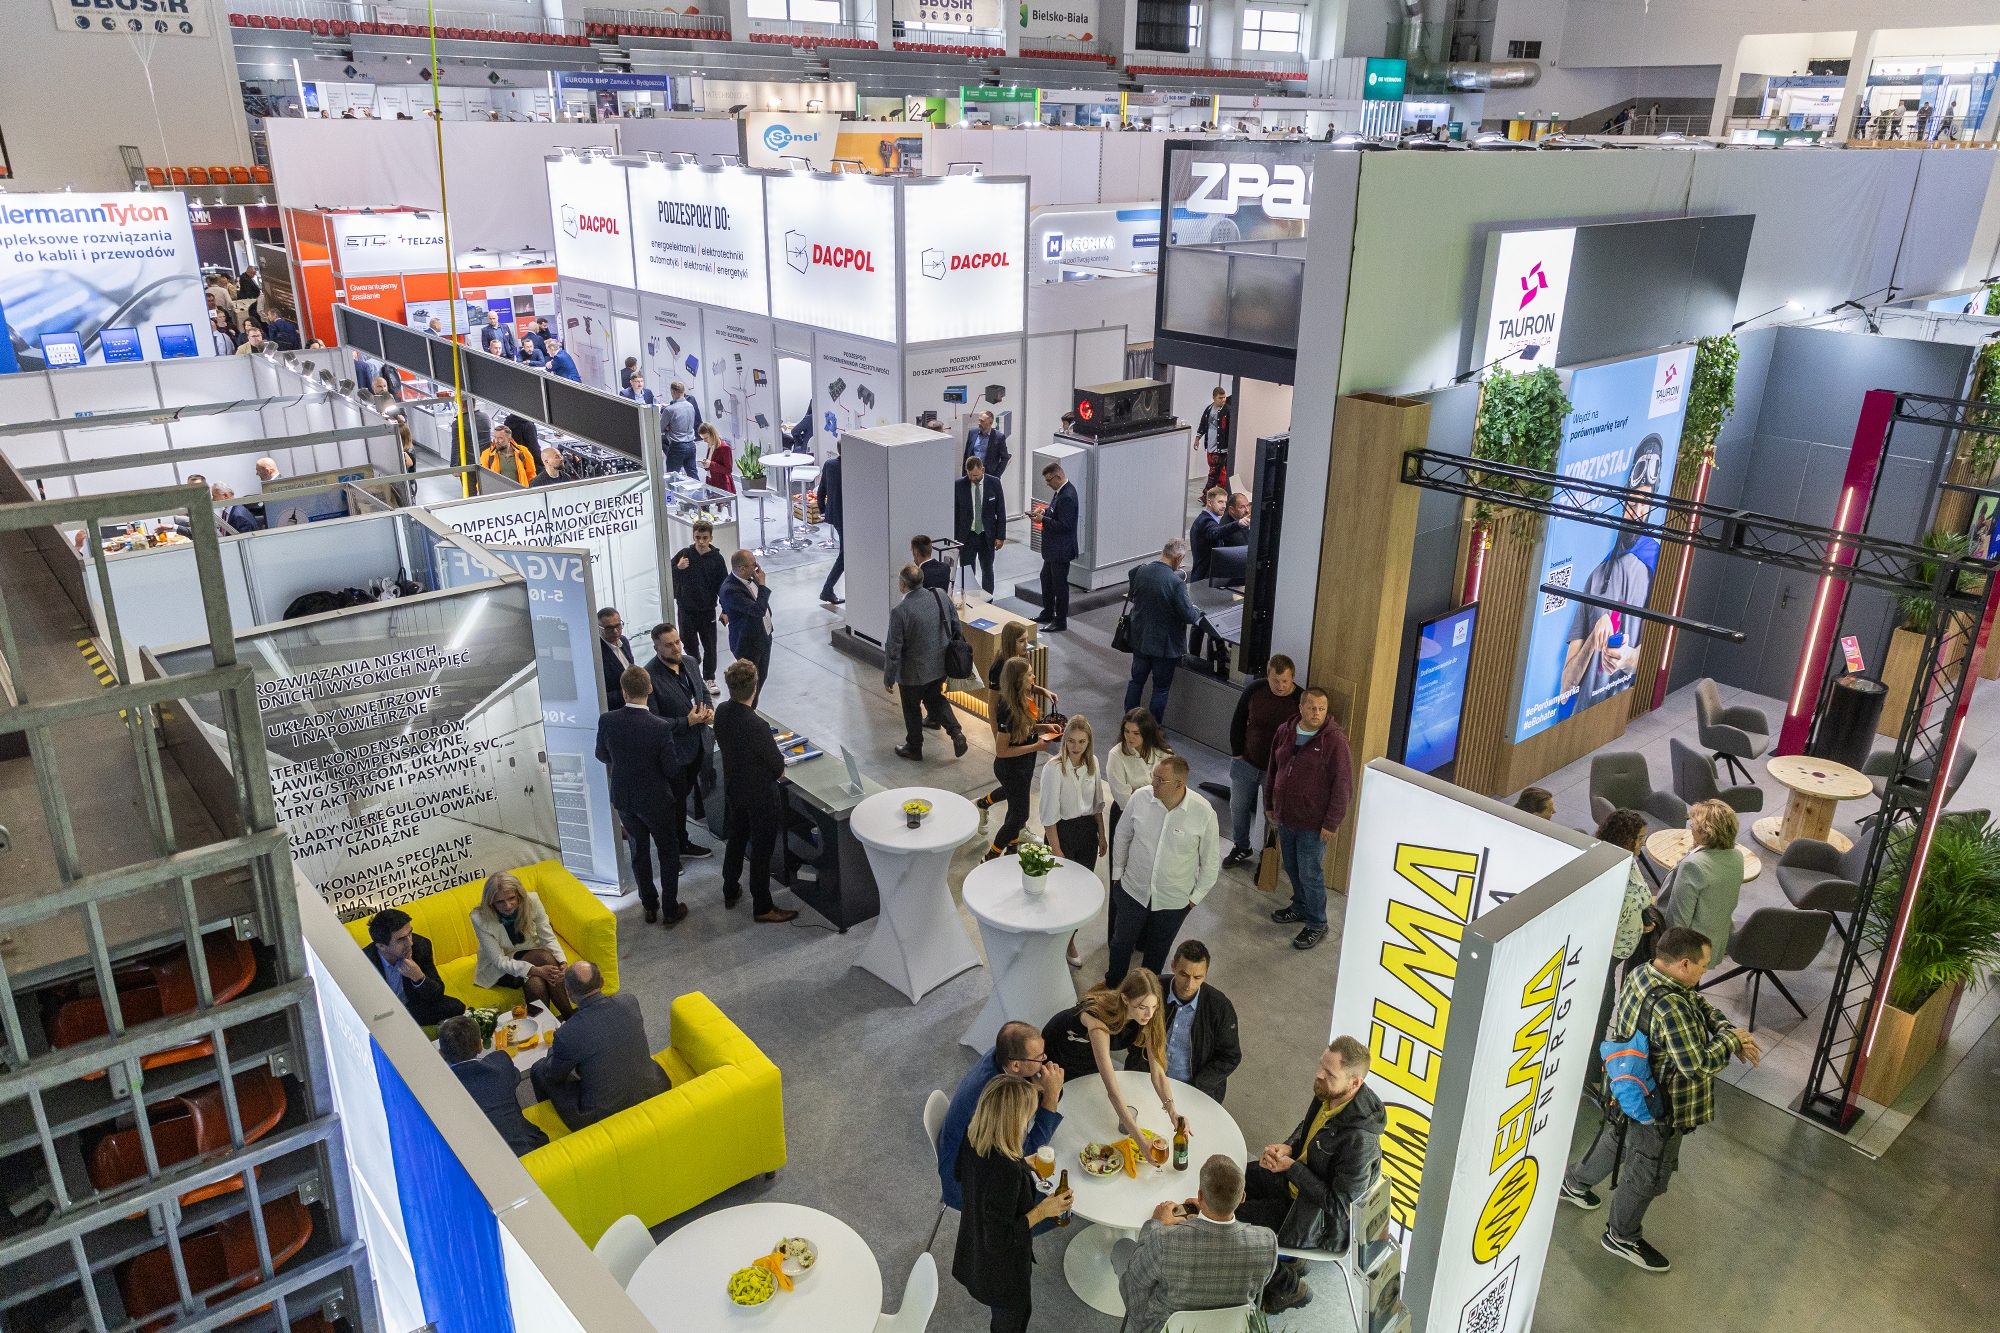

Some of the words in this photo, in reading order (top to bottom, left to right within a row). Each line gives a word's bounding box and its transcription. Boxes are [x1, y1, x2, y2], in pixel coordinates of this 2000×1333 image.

[1032, 10, 1089, 24] Bielsko-Biała
[565, 76, 594, 84] EURODIS
[773, 131, 818, 142] Sonel
[0, 204, 168, 226] lermannTyton
[579, 214, 619, 235] DACPOL
[658, 200, 712, 228] PODZESPOŁY
[714, 206, 731, 230] DO:
[84, 230, 172, 245] rozwiązania
[408, 236, 444, 246] TELZAS
[652, 240, 696, 254] energoelektroniki
[702, 246, 744, 261] elektrotechniki
[14, 250, 34, 262] do
[38, 248, 78, 262] kabli
[82, 248, 87, 260] i
[91, 246, 175, 263] przewodów
[650, 255, 680, 268] automatyki
[684, 260, 712, 273] elektroniki
[717, 266, 748, 280] energetyki
[812, 244, 874, 272] DACPOL
[950, 252, 1009, 270] DACPOL
[350, 282, 398, 292] Gwarantujemy
[1499, 312, 1556, 340] TAURON
[950, 354, 981, 364] PODZESPOŁY
[1570, 422, 1614, 442] porównywarkę
[1614, 416, 1629, 430] taryf
[1573, 410, 1591, 424] Wejdź
[1591, 410, 1598, 419] na
[1564, 446, 1634, 482] KORZYSTAJ
[270, 483, 304, 493] ELECTRICAL
[306, 479, 327, 488] SAFETY
[449, 510, 546, 534] OMPENSACJA
[552, 501, 591, 518] MOCY
[594, 492, 644, 511] BIERNEJ
[469, 528, 518, 544] RACJA
[524, 506, 644, 537] HARMONICZNYCH
[507, 531, 585, 547] OWANIE
[588, 520, 638, 539] ENERGII
[374, 644, 442, 670] NISKICH,
[258, 686, 314, 712] DNICH
[327, 665, 412, 695] WYSOKICH
[415, 648, 470, 674] NAPIĘĆ
[268, 710, 336, 738] UKŁADY
[339, 685, 442, 720] WNĘTRZOWE
[1525, 685, 1580, 718] #ePorównywarka
[292, 734, 298, 746] I
[302, 702, 428, 744] NAPOWIETRZNE
[1523, 708, 1557, 730] #eBohater
[270, 758, 318, 782] TERIE
[322, 719, 470, 765] KONDENSATORÓW,
[334, 734, 467, 780] KOMPENSACYJNE,
[273, 797, 287, 809] Y
[292, 766, 408, 804] SVG/STATCOM,
[412, 746, 470, 770] UKŁADY
[474, 736, 503, 756] SVC,
[320, 781, 396, 810] AKTYWNE
[399, 777, 404, 788] I
[408, 756, 479, 784] PASYWNE
[341, 784, 474, 832] NIEREGULOWANE,
[393, 790, 498, 829] REGULOWANE,
[348, 825, 420, 858] NADĄŻNE
[316, 860, 394, 894] KONANIA
[398, 834, 473, 867] SPECJALNE
[334, 869, 406, 903] PODZIEMI
[378, 864, 464, 898] TOPIKALNY,
[1370, 843, 1478, 1106] ELMA
[1533, 945, 1584, 1137] ENERGIA
[1489, 944, 1566, 1176] ELMA
